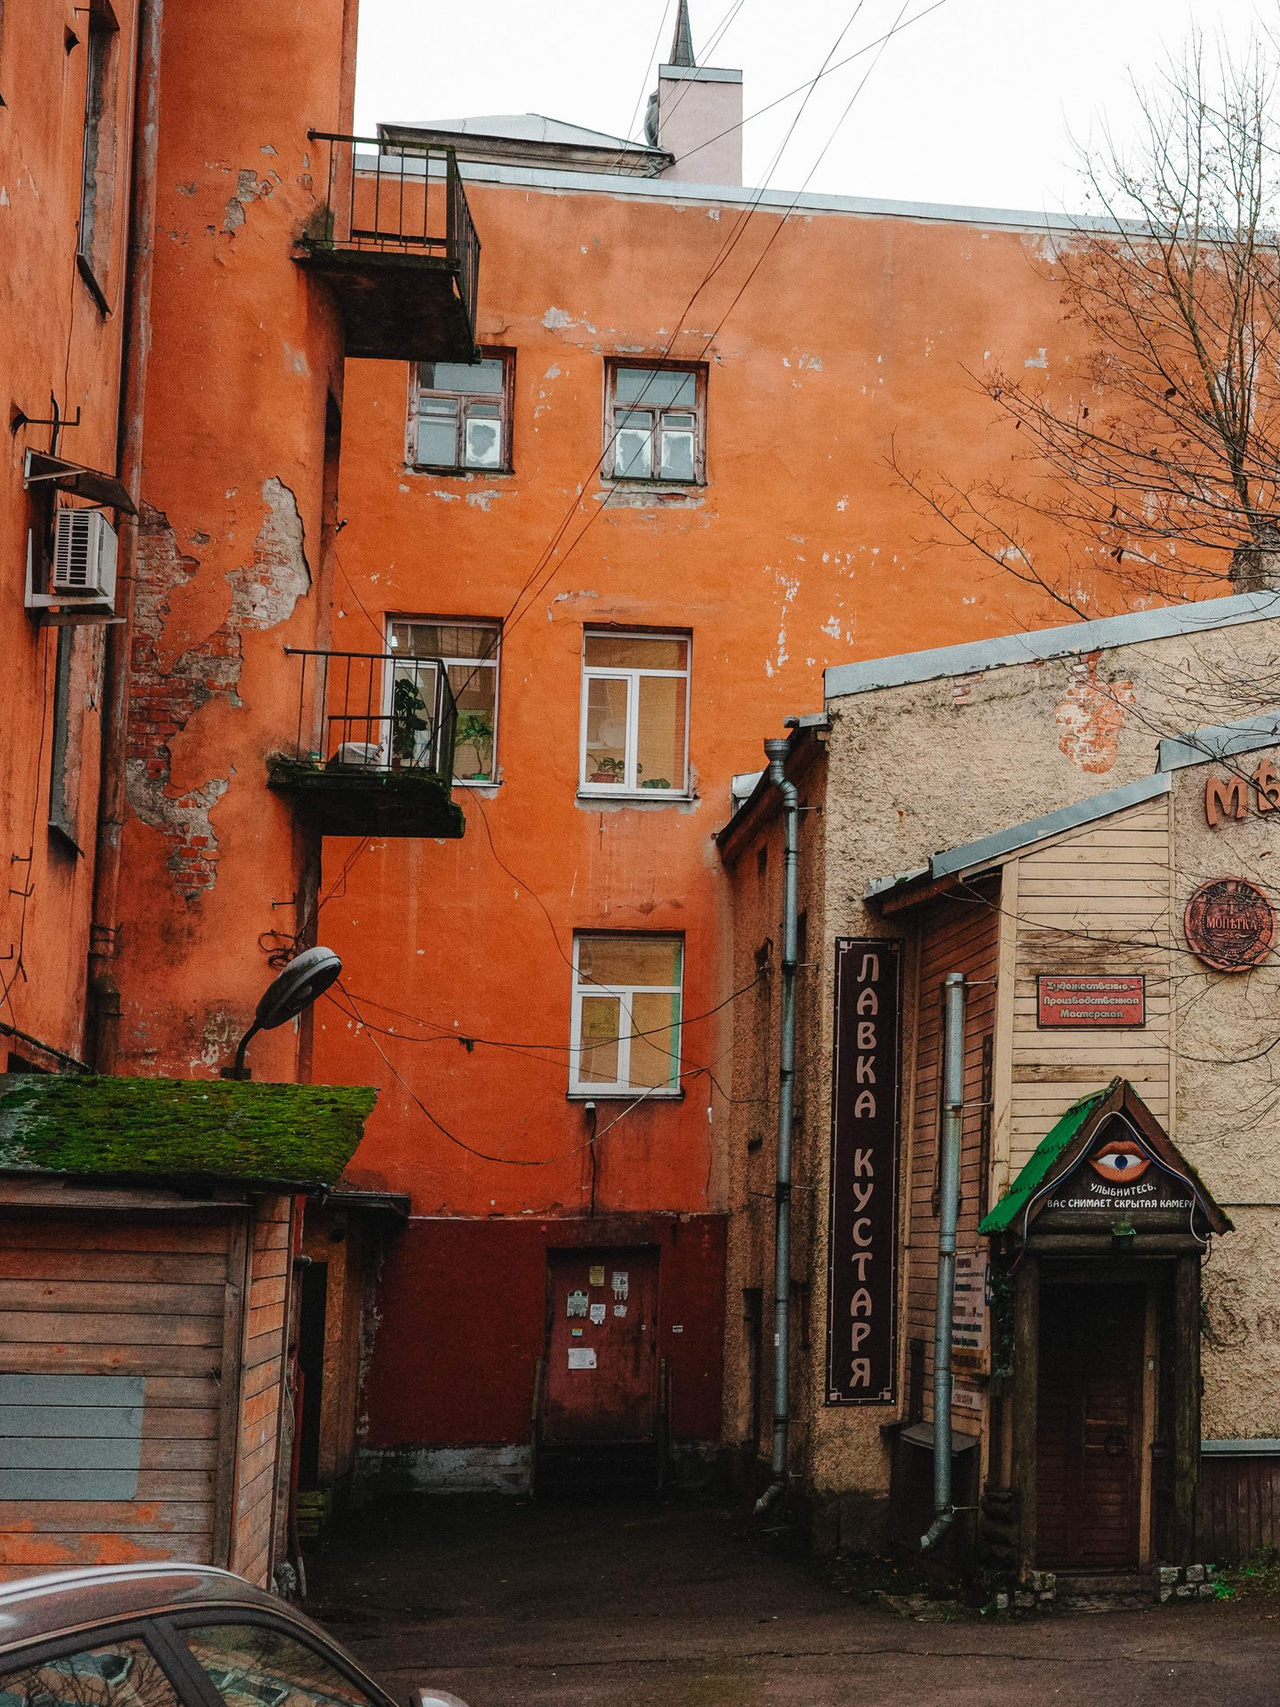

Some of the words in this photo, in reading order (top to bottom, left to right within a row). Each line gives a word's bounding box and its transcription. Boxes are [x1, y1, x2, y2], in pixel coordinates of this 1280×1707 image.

[1043, 996, 1139, 1007] Производственная
[1059, 1009, 1124, 1020] Мастерская
[854, 953, 880, 1119] ЛАВКА
[1047, 1199, 1067, 1208] ВАС
[1067, 1199, 1112, 1208] СНИМАЕТ
[1114, 1199, 1158, 1208] СКРЫТАЯ
[849, 1148, 875, 1388] КУСТАРЯ
